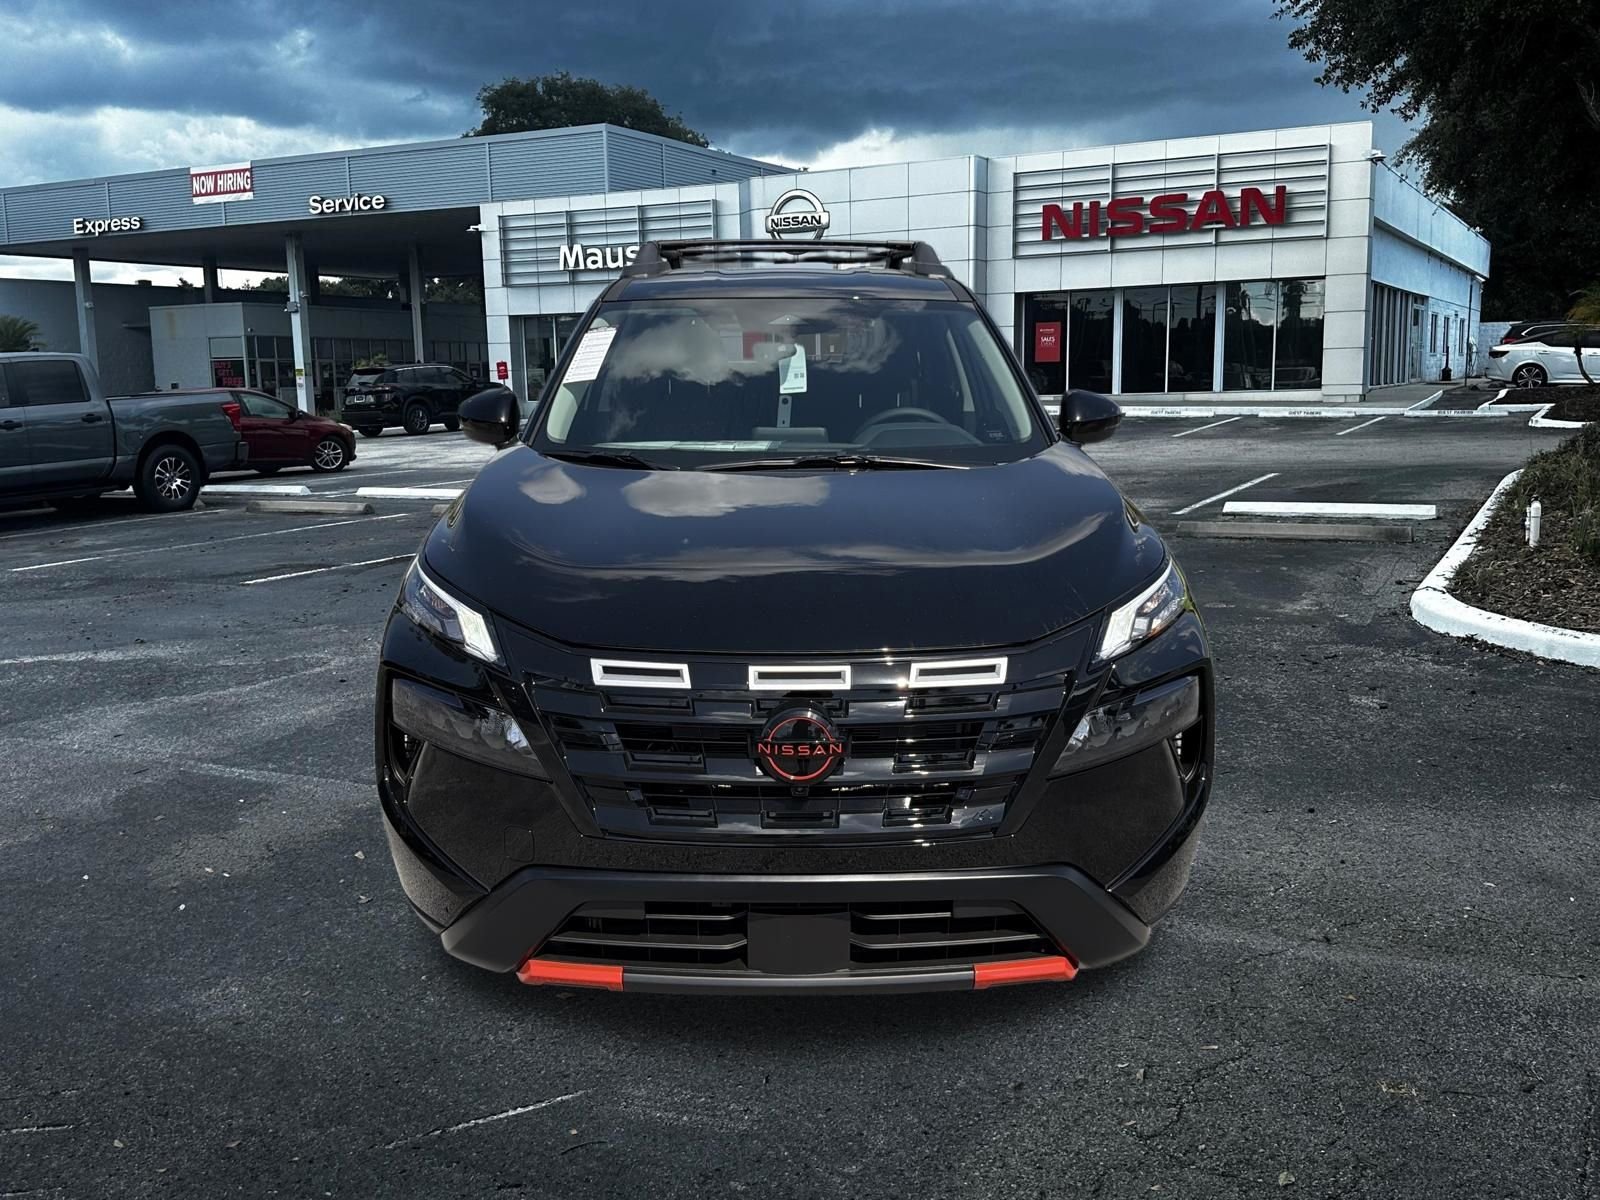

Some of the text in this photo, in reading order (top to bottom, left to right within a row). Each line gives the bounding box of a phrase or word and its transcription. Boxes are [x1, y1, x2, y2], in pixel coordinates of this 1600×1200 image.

[192, 171, 250, 195] NOW HIRING
[309, 193, 385, 214] Service
[1041, 185, 1287, 241] NISSAN
[73, 216, 141, 236] Express
[770, 215, 821, 228] NISSAN
[560, 244, 640, 270] Maus
[223, 377, 243, 385] FREE
[757, 743, 843, 755] NISSAN
